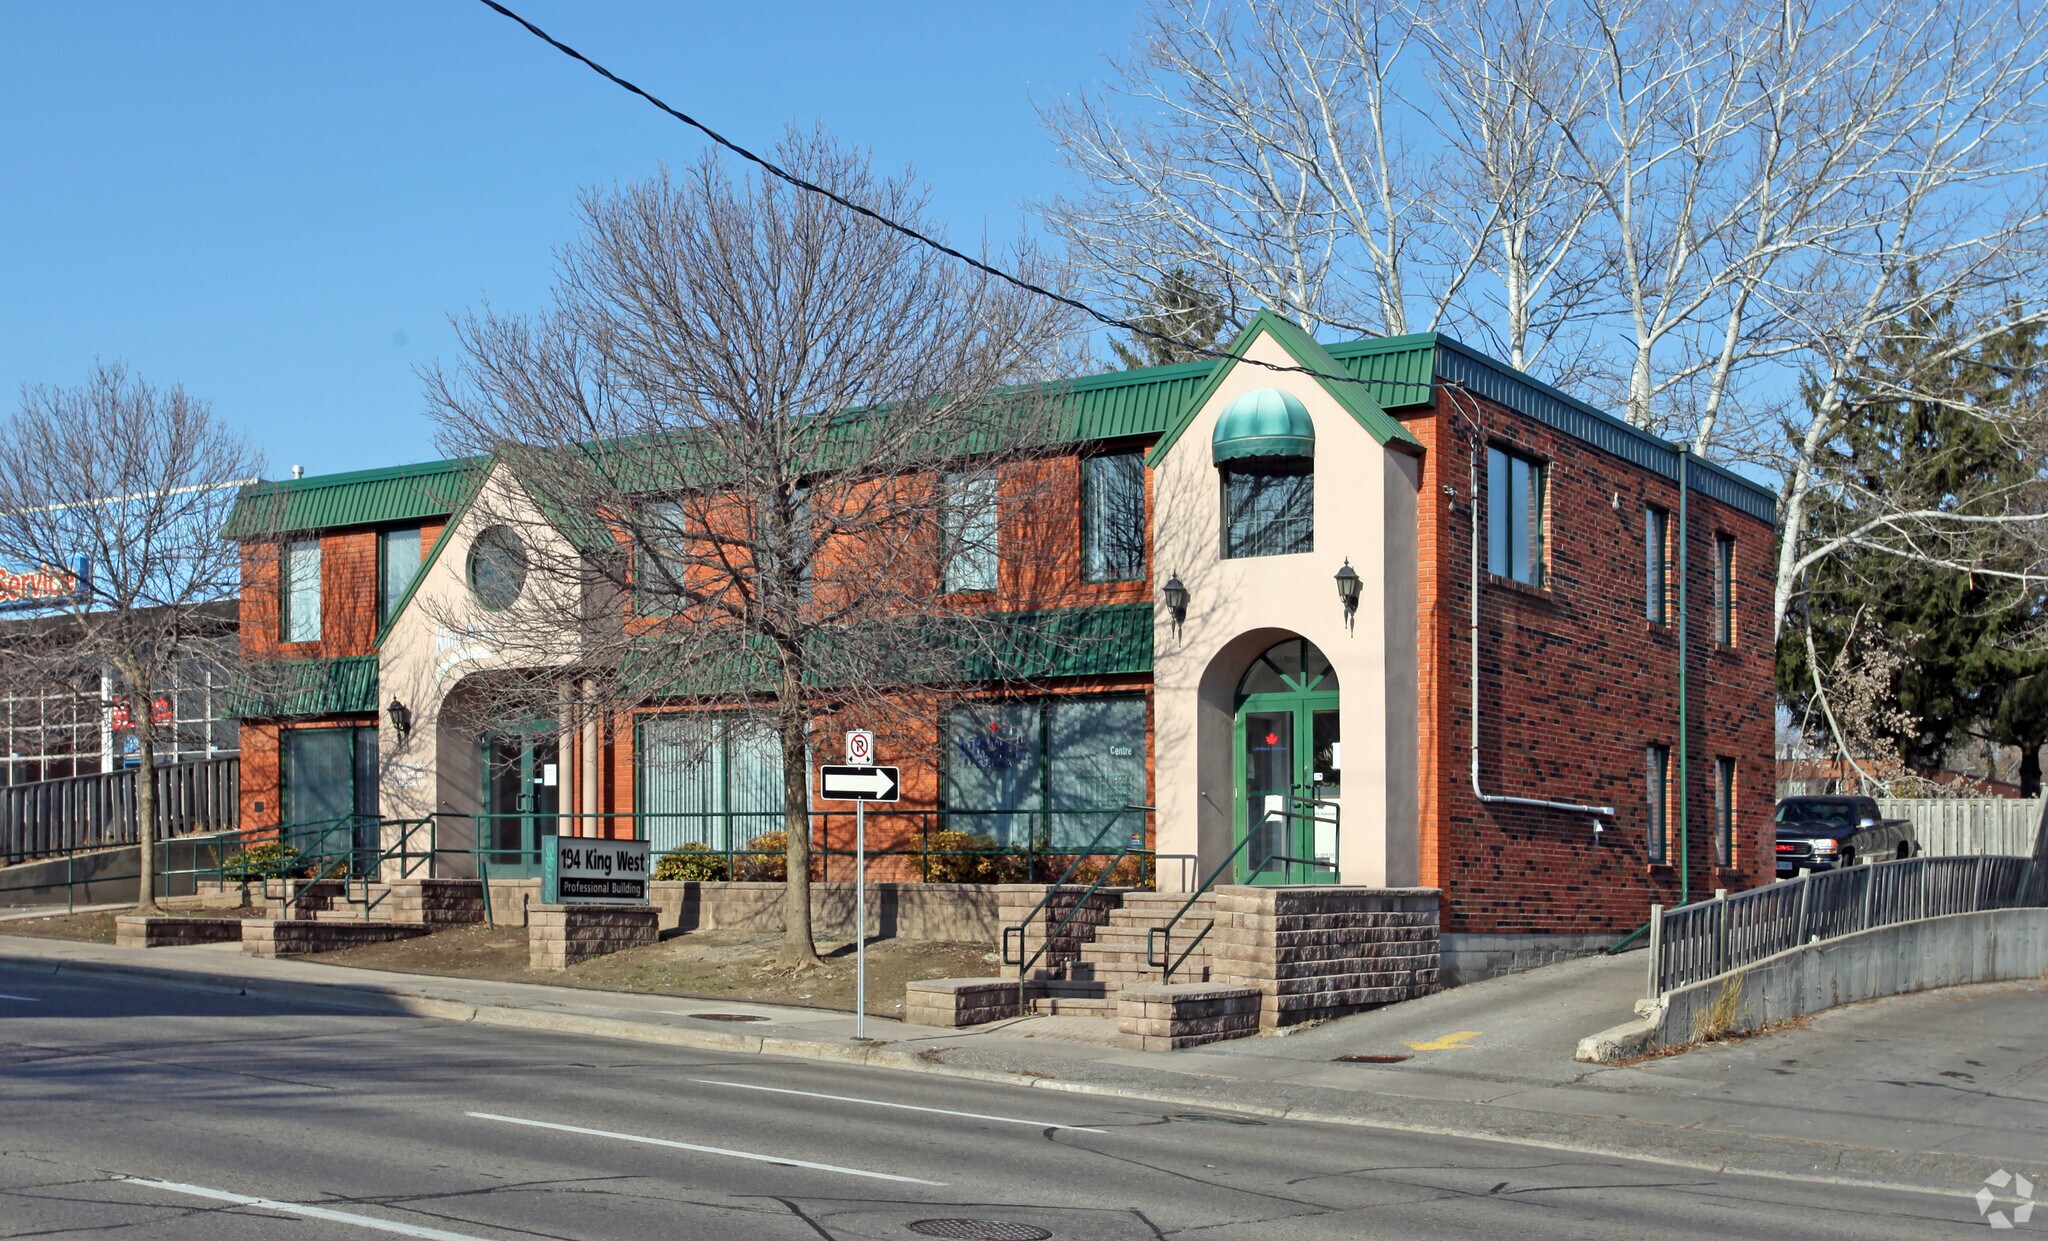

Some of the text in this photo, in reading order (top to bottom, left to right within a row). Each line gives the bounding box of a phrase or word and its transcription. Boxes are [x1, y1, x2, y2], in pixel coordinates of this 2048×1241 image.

[1110, 745, 1132, 756] Centre
[561, 848, 645, 876] 194 King West
[563, 880, 641, 897] Professional Building
